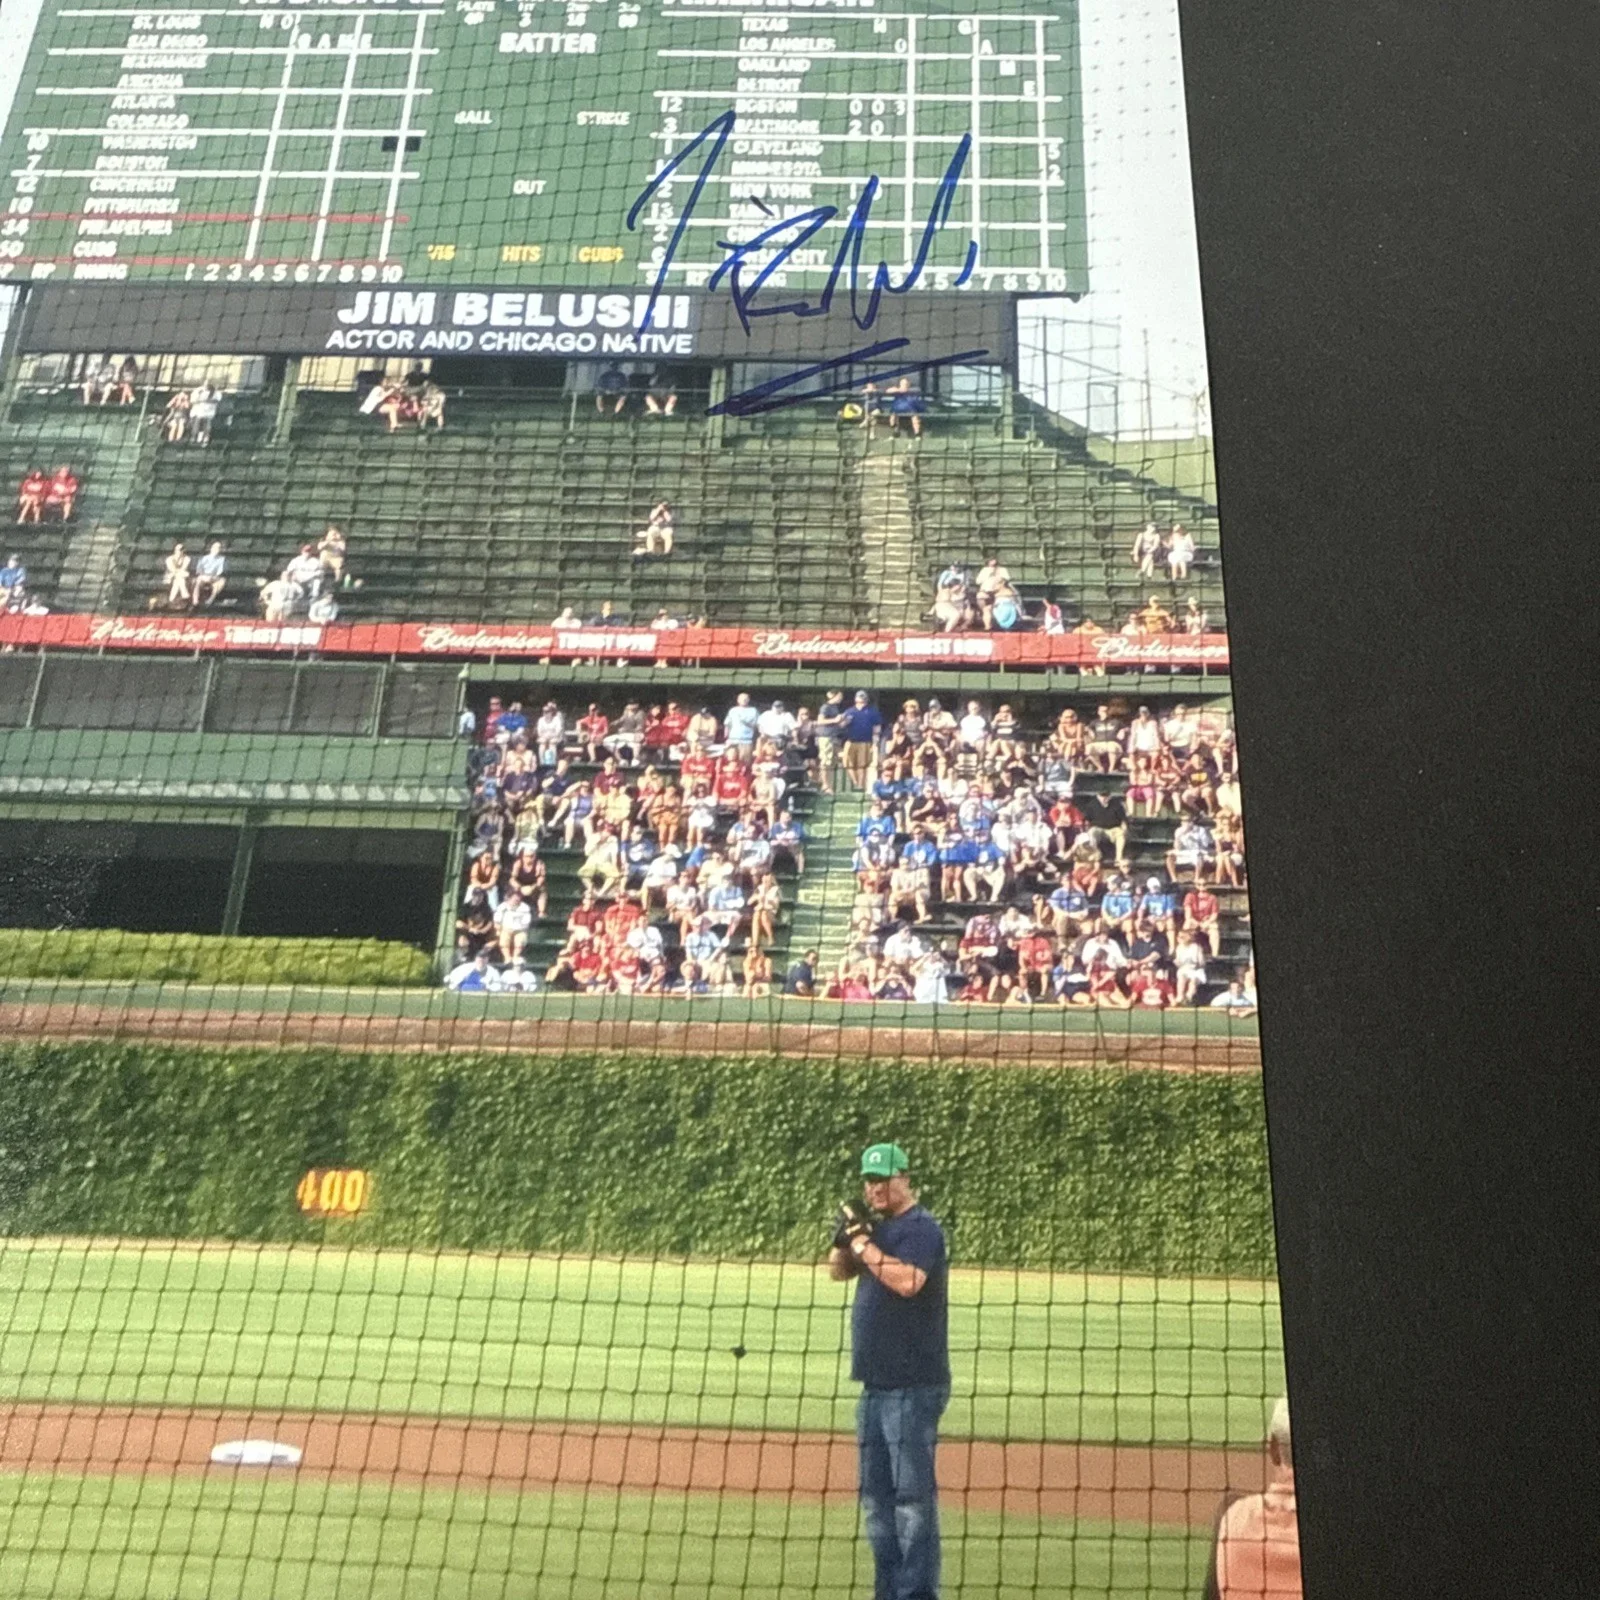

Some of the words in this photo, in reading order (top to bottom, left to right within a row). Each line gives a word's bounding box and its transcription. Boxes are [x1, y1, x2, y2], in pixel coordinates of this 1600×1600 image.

[742, 18, 789, 32] TEXAS
[499, 33, 597, 53] BATTER
[739, 37, 769, 51] LOS
[769, 37, 836, 52] ANGELES
[738, 58, 811, 72] OAKLAND
[737, 78, 801, 92] DETROIT
[111, 95, 176, 109] ATLANTA
[660, 97, 683, 113] 12
[735, 99, 798, 113] BOSTON
[849, 100, 863, 115] 0
[871, 100, 885, 115] 0
[455, 110, 493, 125] BALL
[576, 111, 631, 126] STRIKE
[663, 117, 677, 134] 3
[734, 119, 820, 134] BALTIMORE
[733, 141, 824, 156] CLEVELAND
[513, 180, 547, 195] OUT
[729, 183, 766, 198] NEW
[769, 183, 813, 199] YORK
[73, 240, 118, 257] CUBS
[502, 246, 541, 262] HITS
[791, 249, 828, 264] CITY
[184, 263, 195, 281] 1
[203, 264, 221, 281] 2
[226, 264, 243, 281] 3
[249, 264, 265, 282] 4
[272, 265, 288, 282] 5
[294, 265, 310, 282] 6
[317, 265, 332, 282] 7
[339, 265, 355, 282] 8
[361, 265, 377, 282] 9
[382, 265, 403, 283] 10
[935, 274, 949, 290] 5
[980, 275, 994, 290] 7
[1003, 275, 1018, 290] 8
[1026, 275, 1041, 290] 9
[1046, 275, 1067, 291] 10
[337, 291, 436, 326] JIM
[451, 292, 692, 329] BELUSHI
[325, 329, 414, 351] ACTOR
[418, 330, 474, 353] AND
[478, 331, 595, 353] CHICAGO
[601, 333, 694, 355] NATIVE
[417, 626, 553, 652] Budweiser
[752, 631, 890, 656] Budweiser
[296, 1169, 365, 1212] 400
